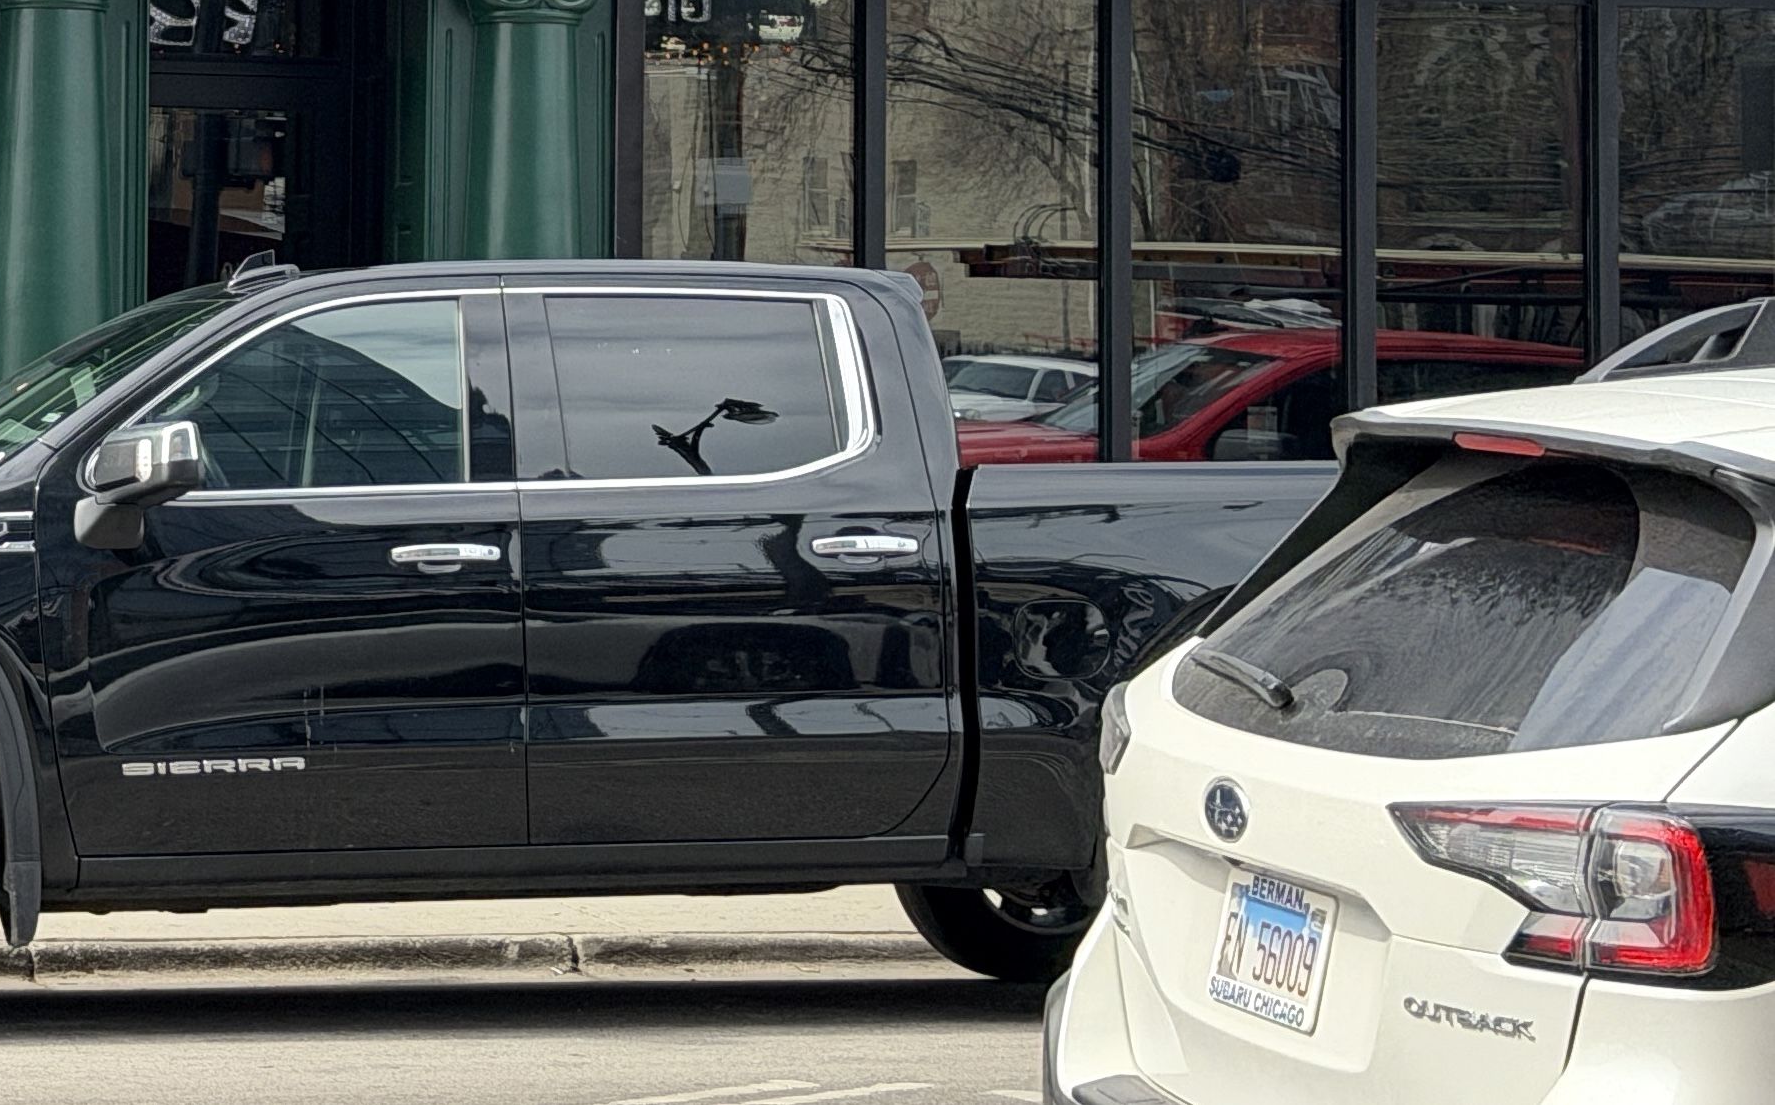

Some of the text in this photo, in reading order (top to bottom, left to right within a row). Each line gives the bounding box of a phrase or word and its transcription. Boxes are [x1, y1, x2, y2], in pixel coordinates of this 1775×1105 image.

[121, 756, 306, 776] SIERRA
[1251, 875, 1305, 910] BERMAN
[1252, 921, 1318, 998] 56009
[1208, 975, 1305, 1028] SUBARU CHICAGO
[1403, 996, 1537, 1043] OUTBACK
